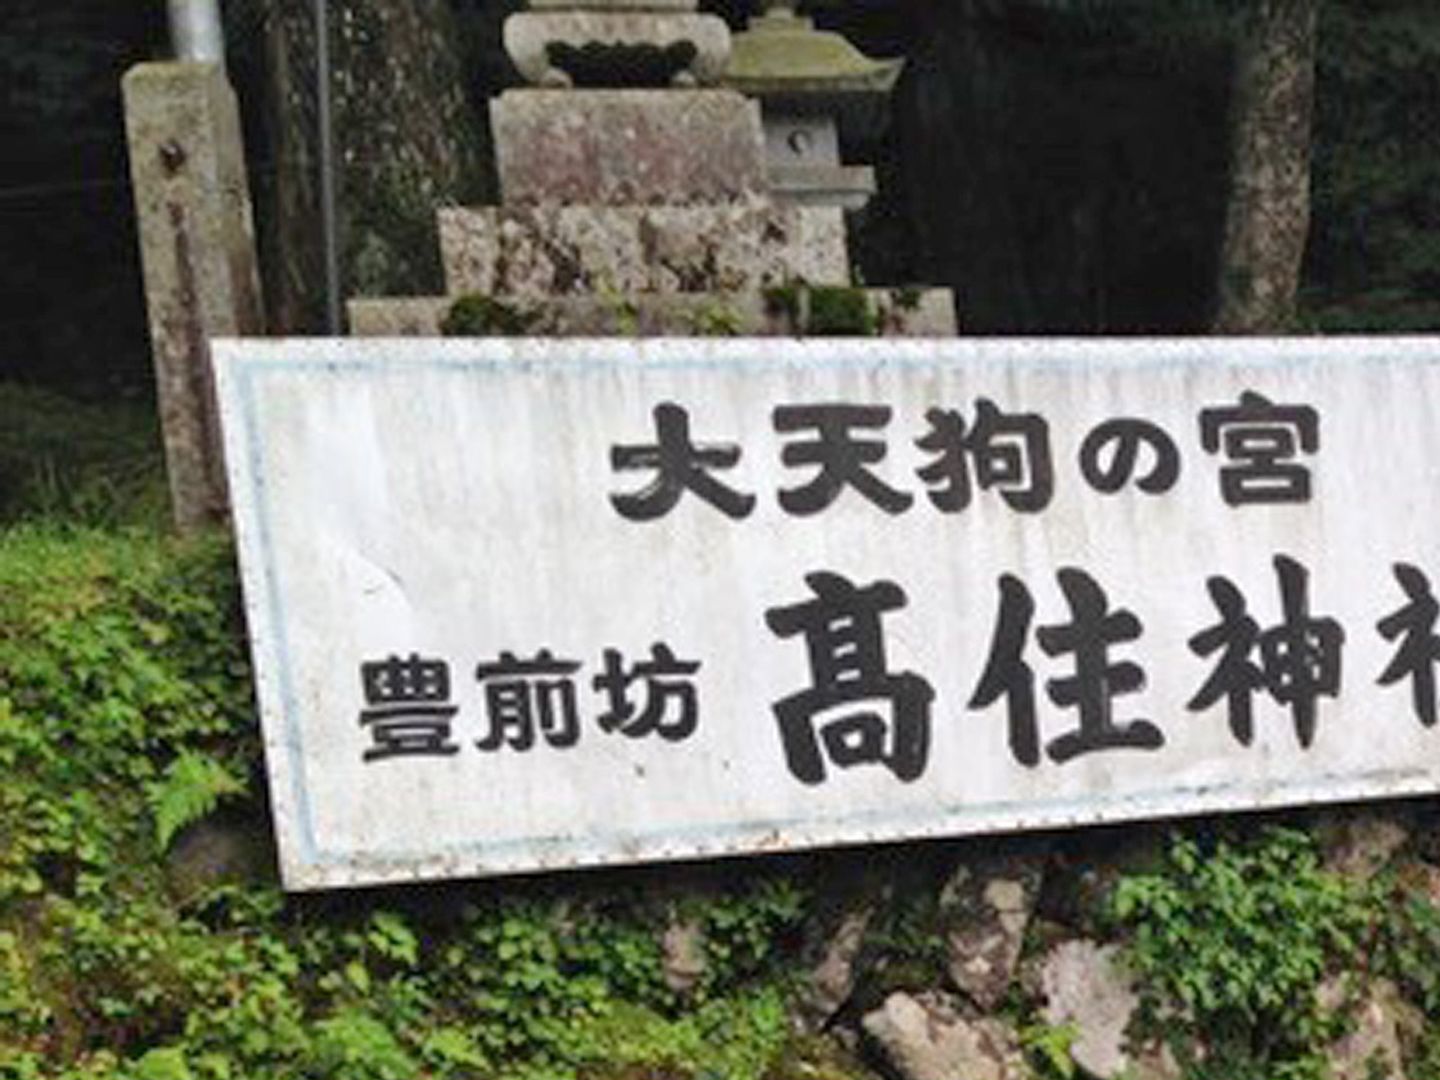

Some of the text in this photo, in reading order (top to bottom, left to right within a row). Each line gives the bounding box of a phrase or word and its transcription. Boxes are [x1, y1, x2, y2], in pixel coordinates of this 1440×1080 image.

[609, 391, 1320, 521] 大天狗の宮
[359, 641, 701, 763] 豊前坊
